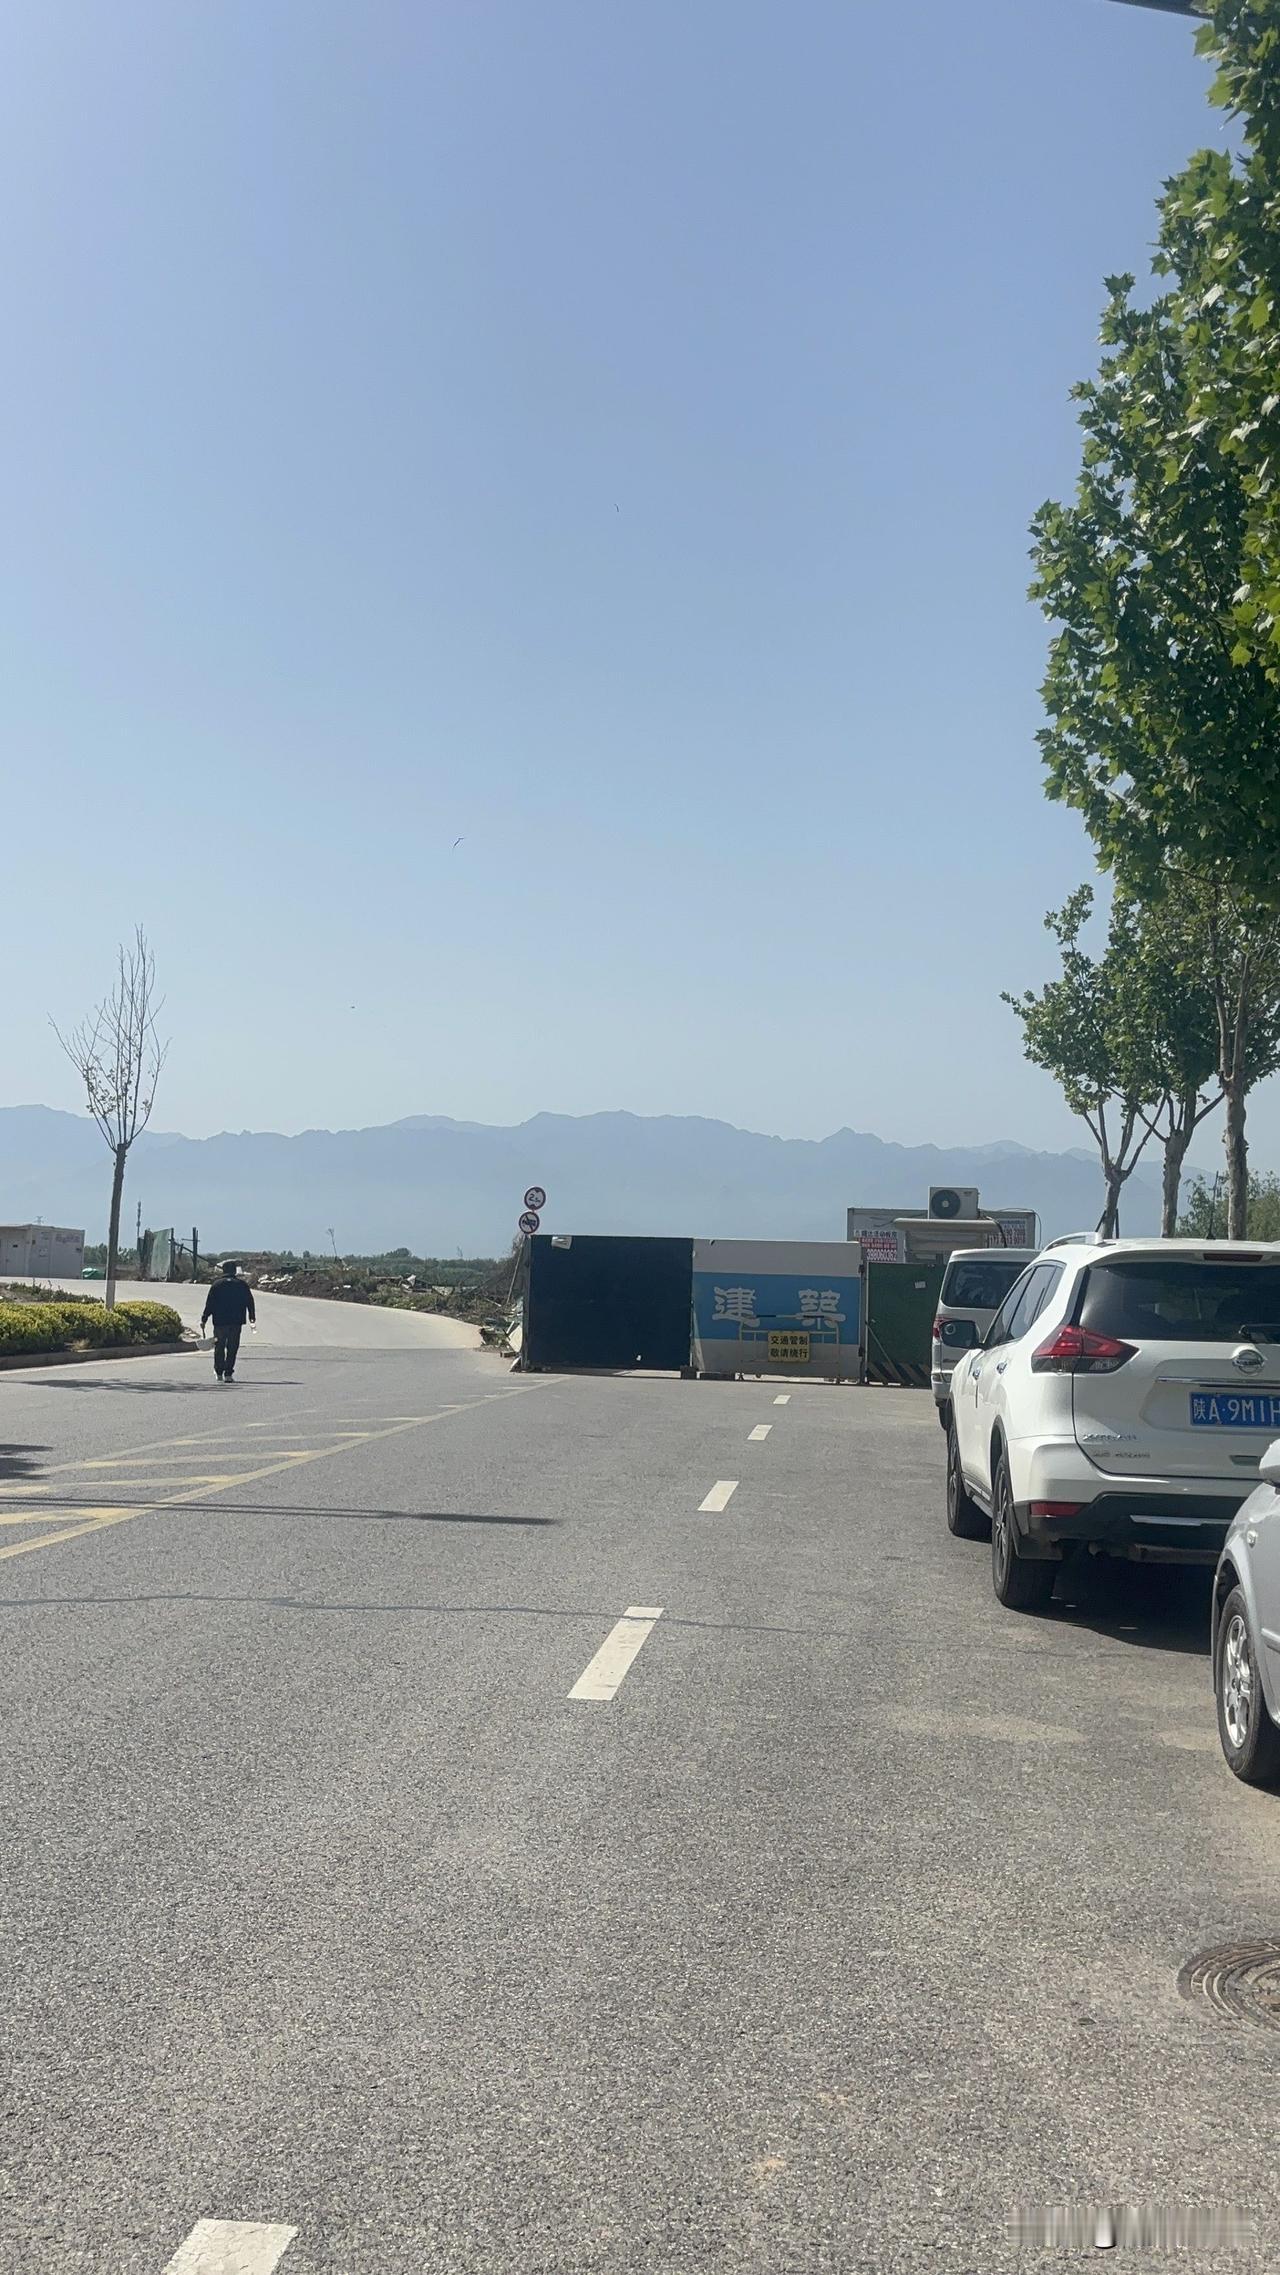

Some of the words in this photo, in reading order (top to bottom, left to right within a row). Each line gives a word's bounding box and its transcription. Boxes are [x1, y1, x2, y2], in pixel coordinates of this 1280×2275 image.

[770, 1335, 808, 1345] 交通管制
[770, 1348, 808, 1358] 敬请绕行
